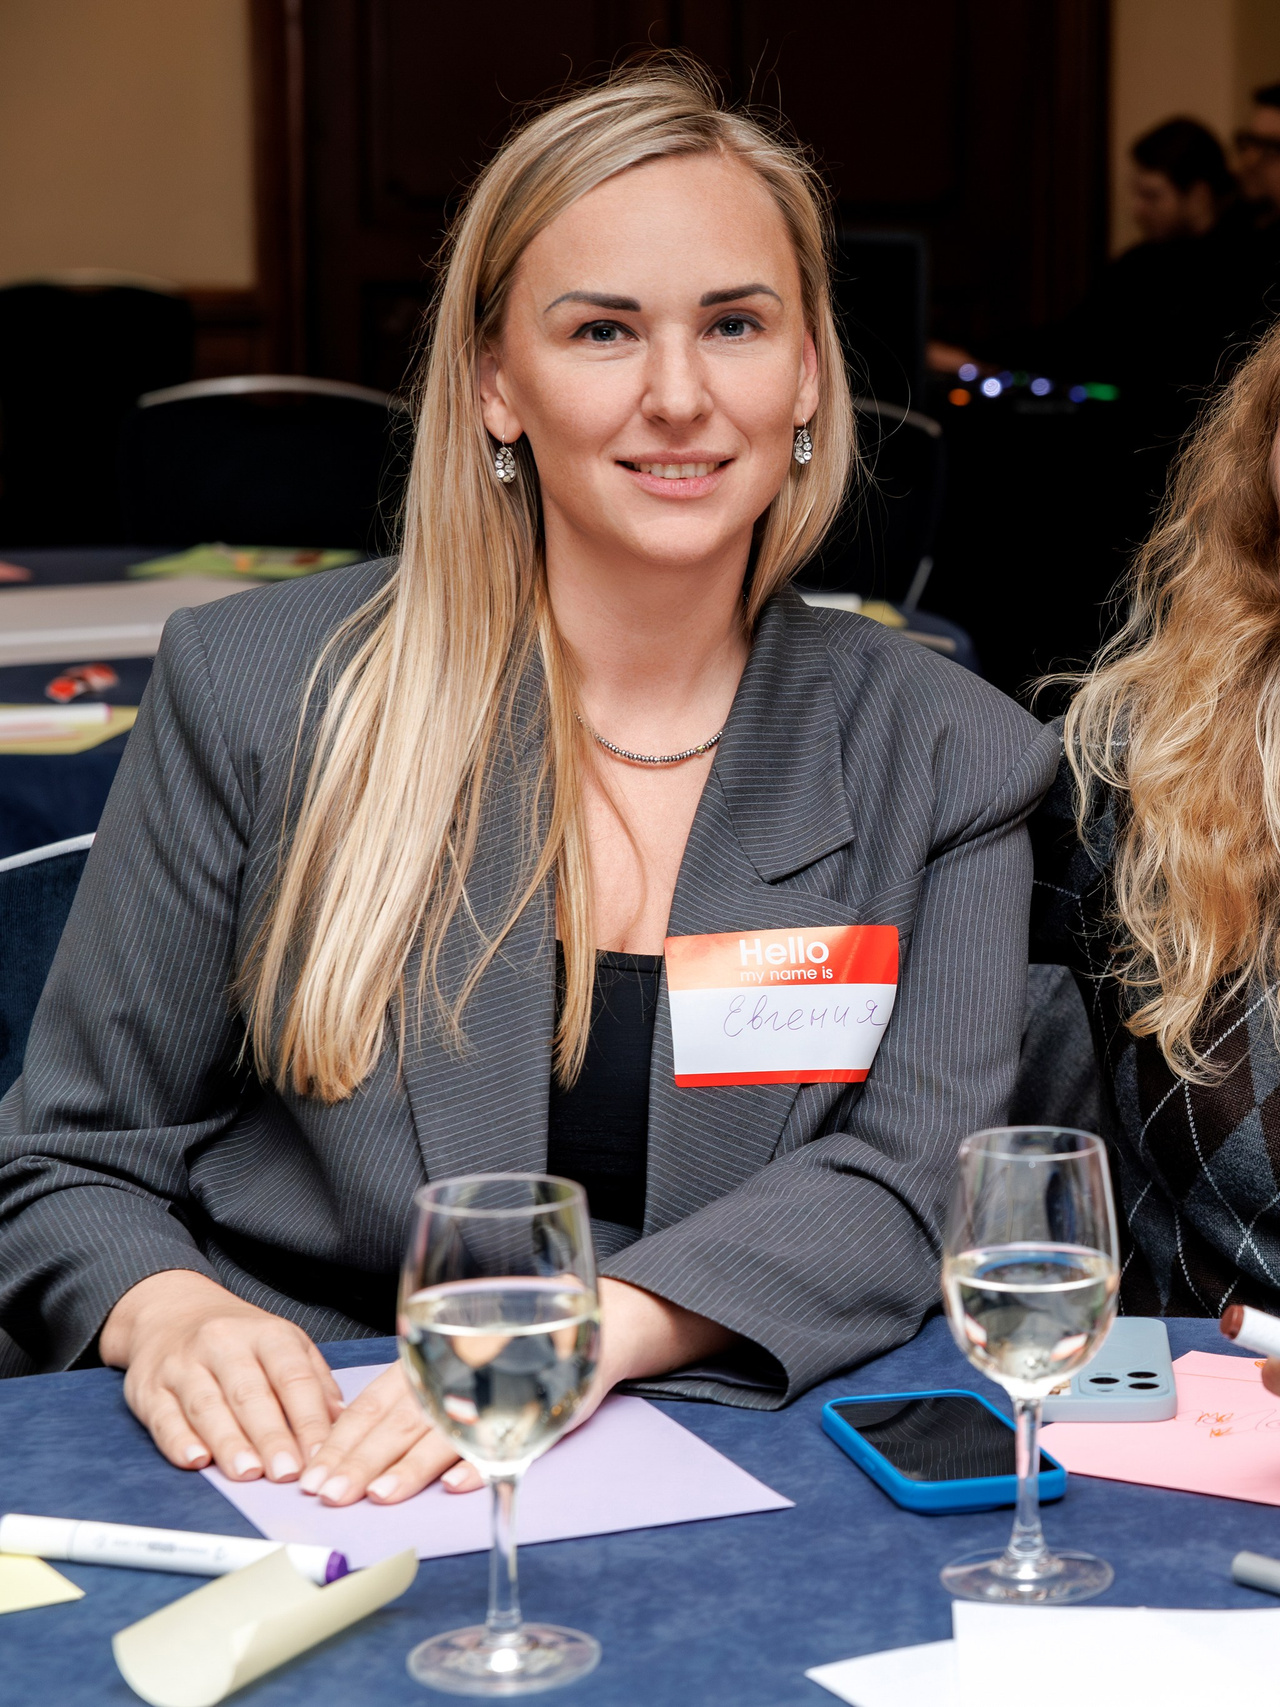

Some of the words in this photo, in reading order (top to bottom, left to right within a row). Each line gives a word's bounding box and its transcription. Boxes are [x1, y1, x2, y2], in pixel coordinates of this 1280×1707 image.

[738, 936, 829, 966] Hello
[740, 970, 765, 984] my
[769, 968, 817, 981] name
[822, 966, 833, 979] is
[723, 994, 888, 1037] Евгения
